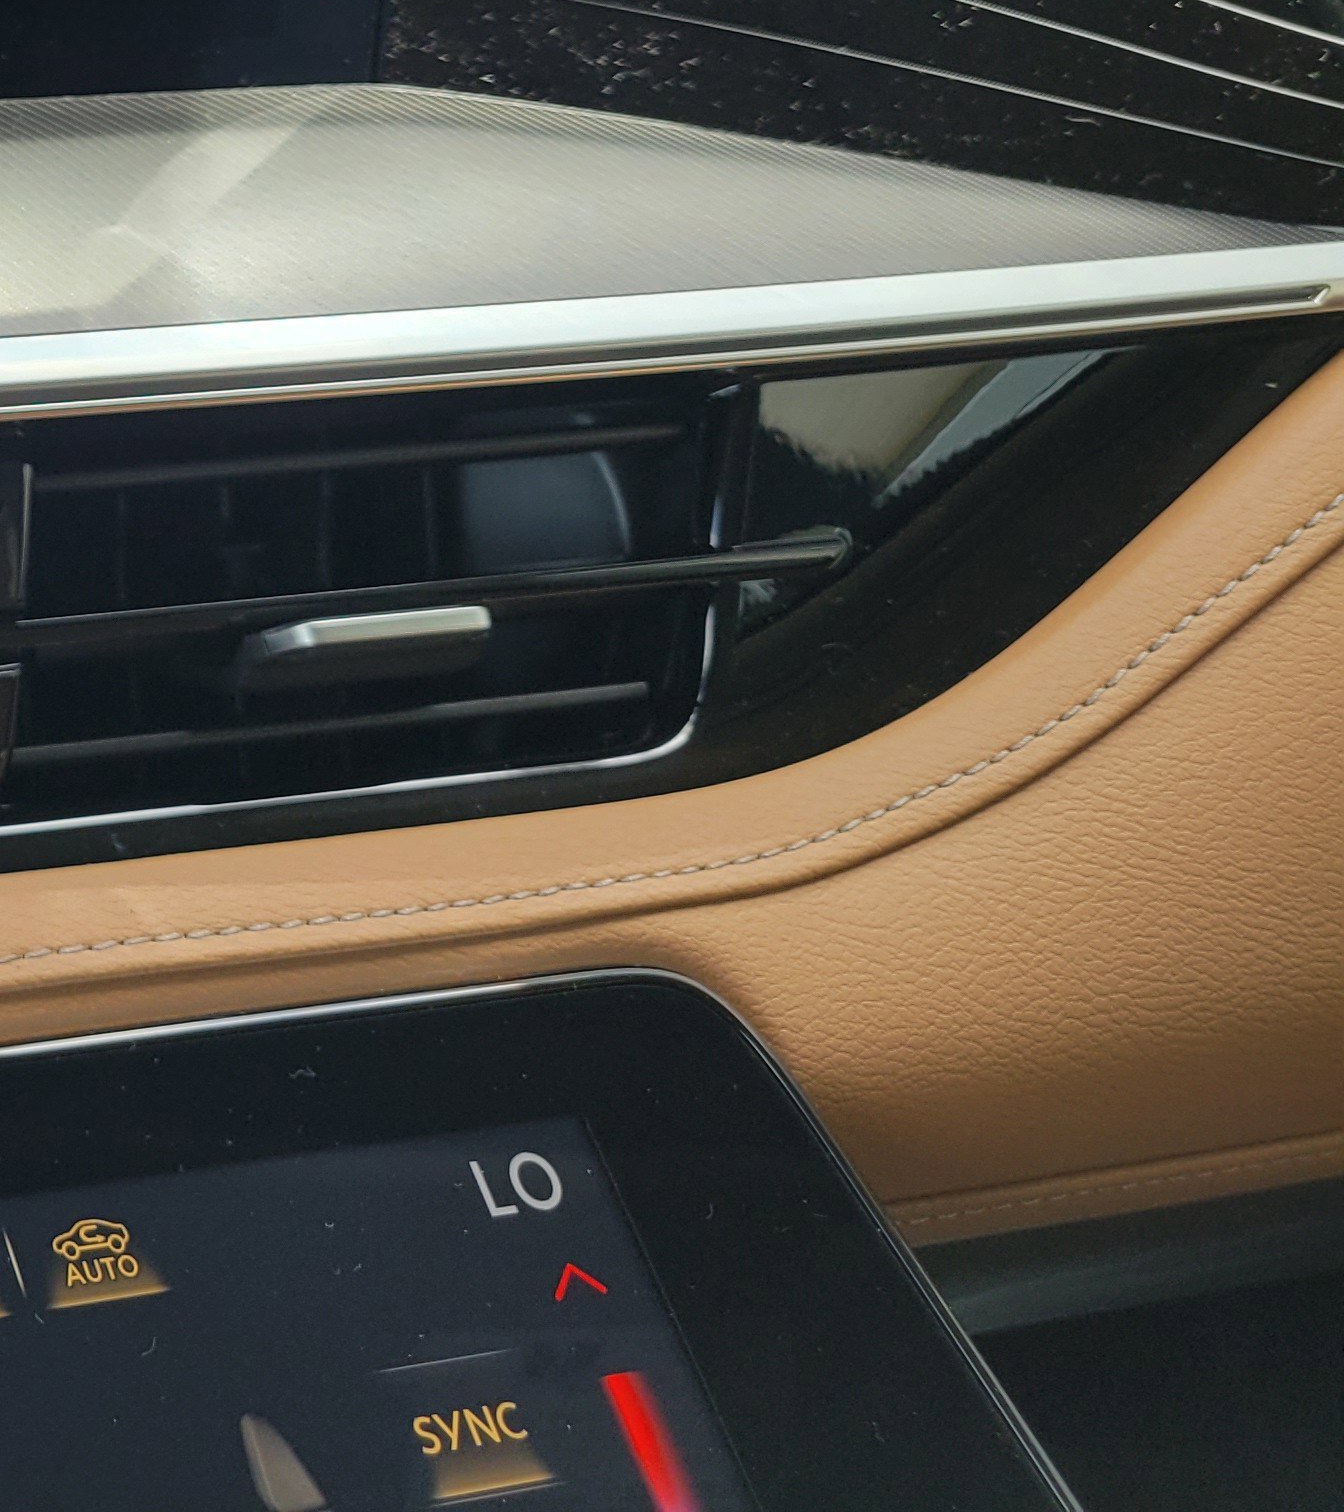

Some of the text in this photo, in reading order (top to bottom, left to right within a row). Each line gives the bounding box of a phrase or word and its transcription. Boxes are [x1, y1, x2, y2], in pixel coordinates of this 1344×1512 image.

[467, 1150, 564, 1219] LO
[64, 1254, 140, 1288] AUTO
[411, 1400, 529, 1456] SYNC
